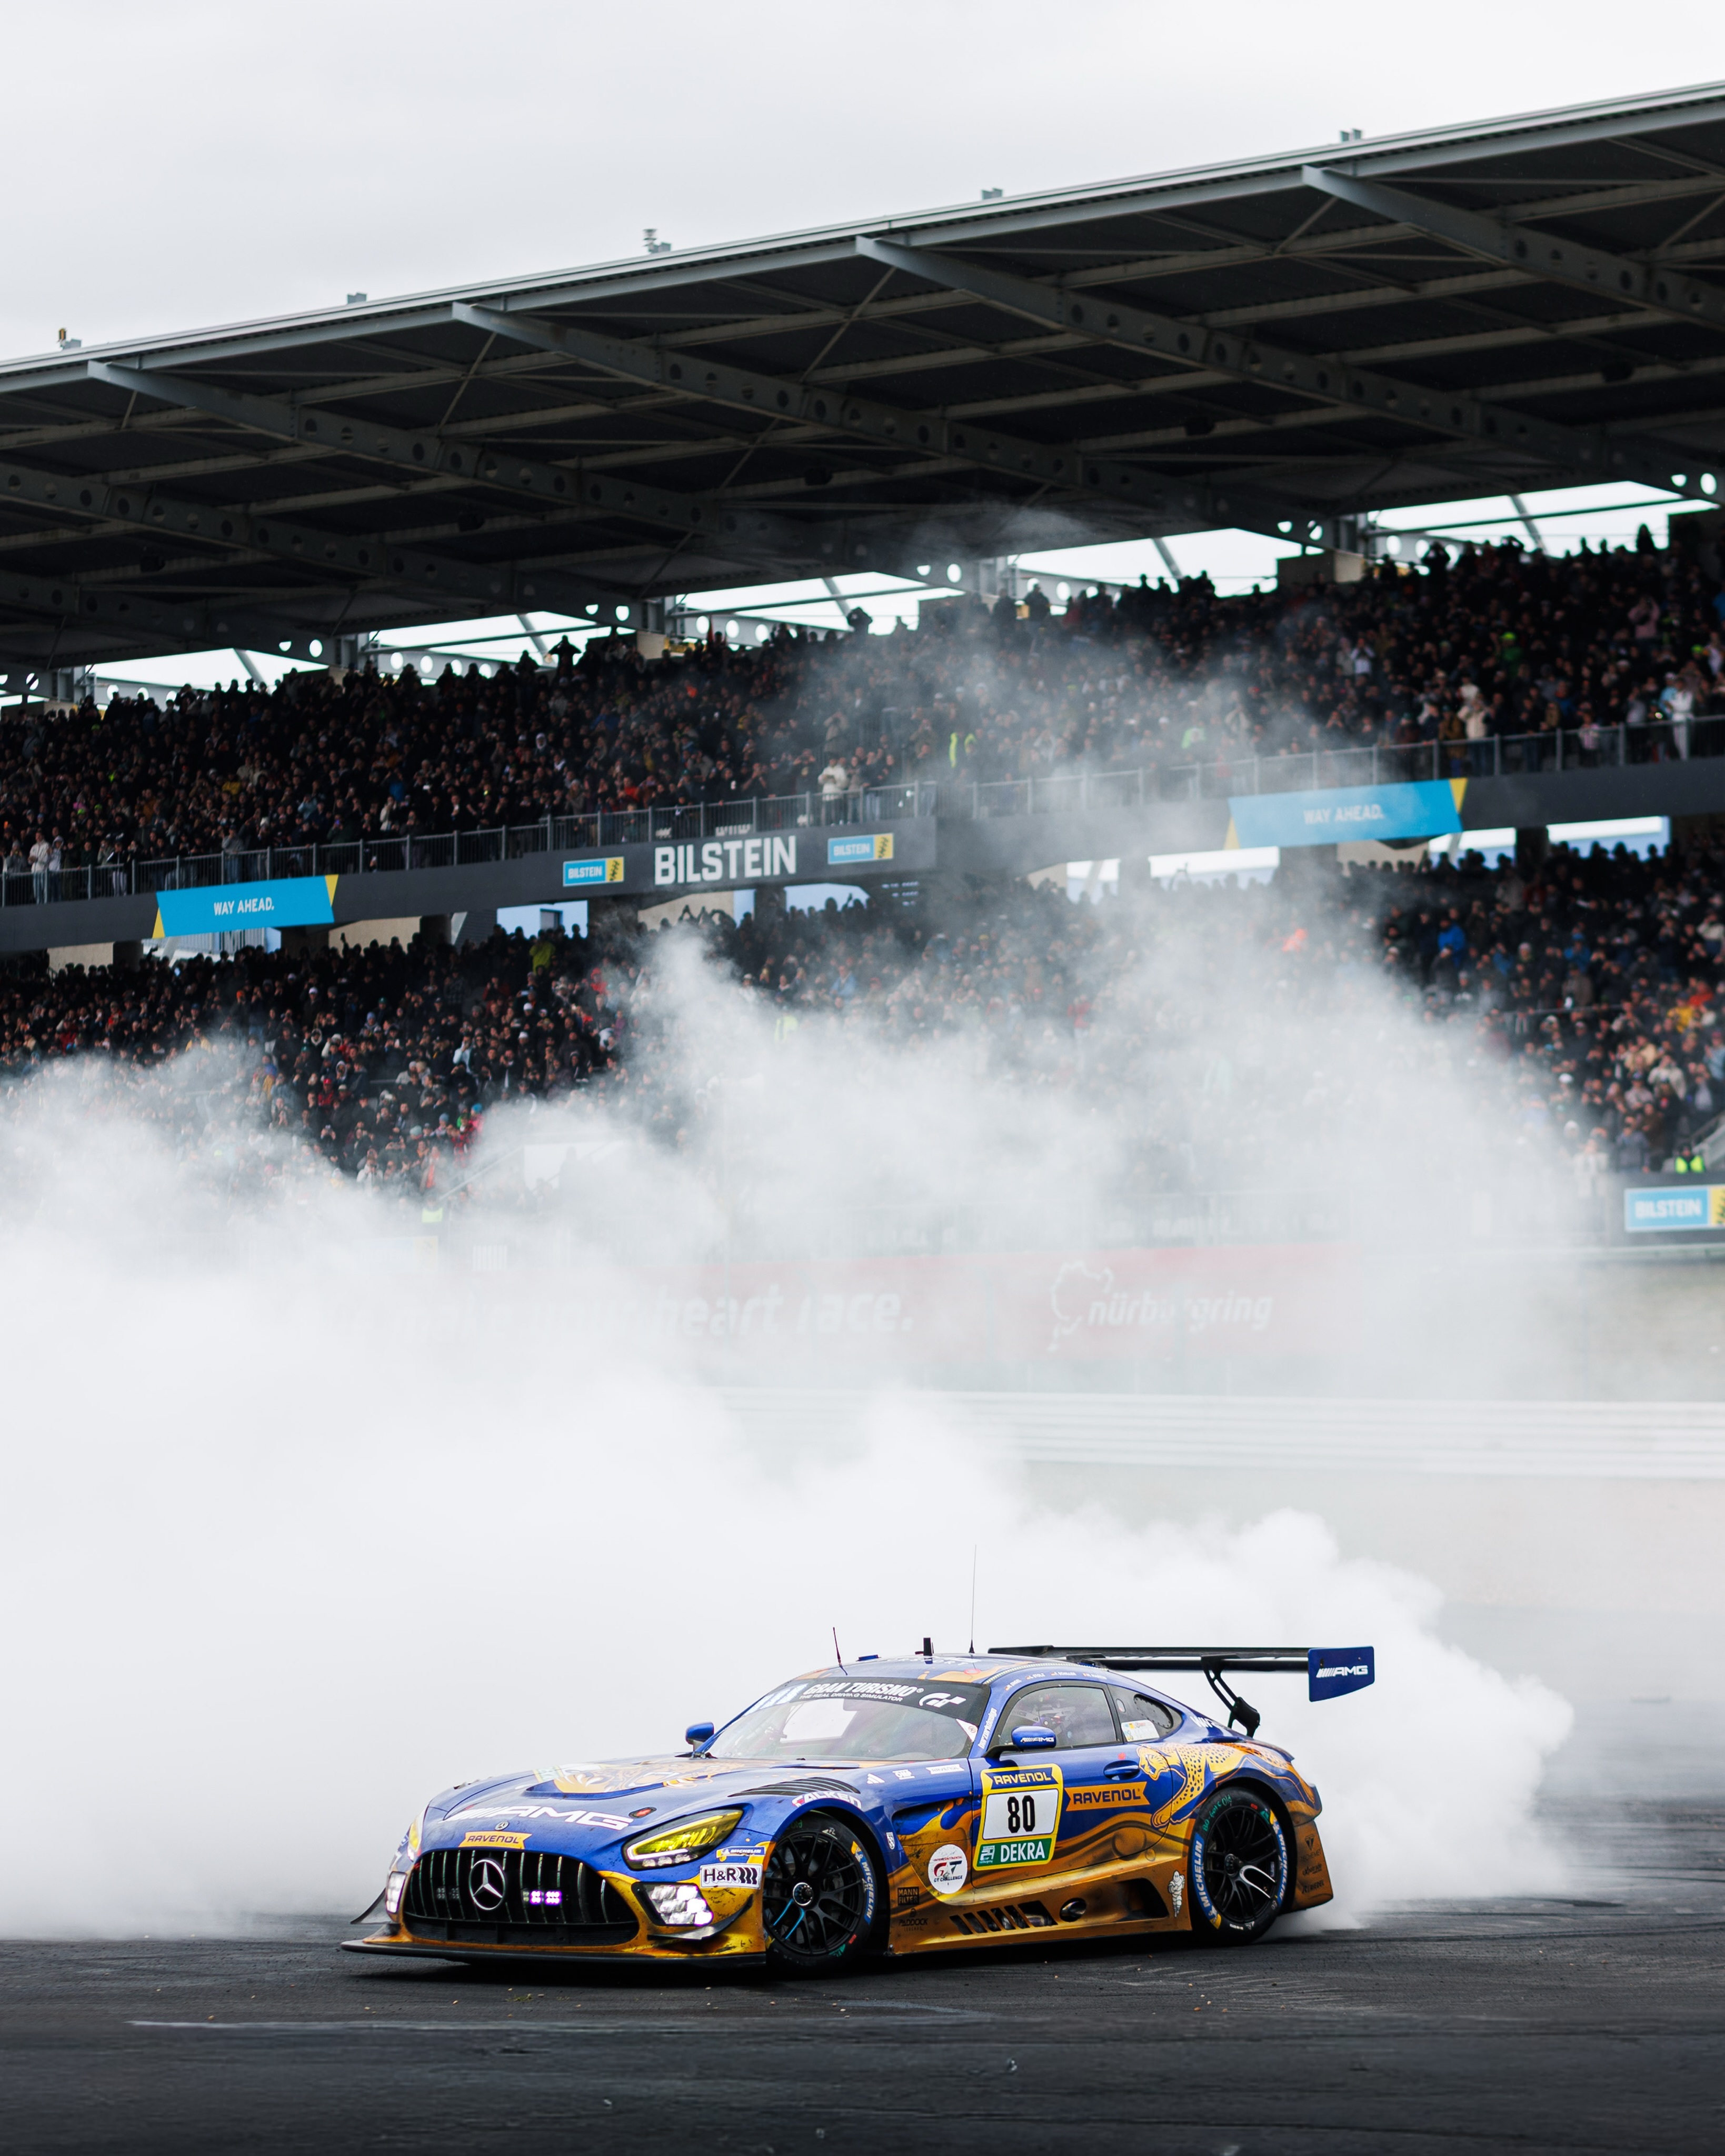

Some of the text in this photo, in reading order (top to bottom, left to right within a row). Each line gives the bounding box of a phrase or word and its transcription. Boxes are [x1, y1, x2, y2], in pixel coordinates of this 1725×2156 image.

[1303, 804, 1384, 825] WAY AHEAD.
[833, 843, 870, 856] BILSTEIN
[654, 835, 797, 885] BILSTEIN
[568, 866, 603, 879] BILSTEIN
[213, 896, 274, 916] WAY AHEAD.
[1634, 1198, 1702, 1219] BILSTEIN
[1332, 1665, 1368, 1676] AMG
[803, 1682, 851, 1695] GRAN
[860, 1693, 903, 1702] SIMULATOR
[993, 1772, 1051, 1785] RAVENOL
[792, 1791, 862, 1810] FALKEN
[1073, 1789, 1141, 1804] RAVENOL
[492, 1805, 634, 1830] AMG
[1007, 1795, 1035, 1834] 80
[467, 1835, 520, 1844] RAVENOL
[1001, 1841, 1045, 1863] DEKRA
[704, 1868, 737, 1882] H&R
[1194, 1840, 1211, 1908] MICHELIN
[1278, 1834, 1288, 1901] MICHELIN
[861, 1861, 874, 1919] MICHELIN
